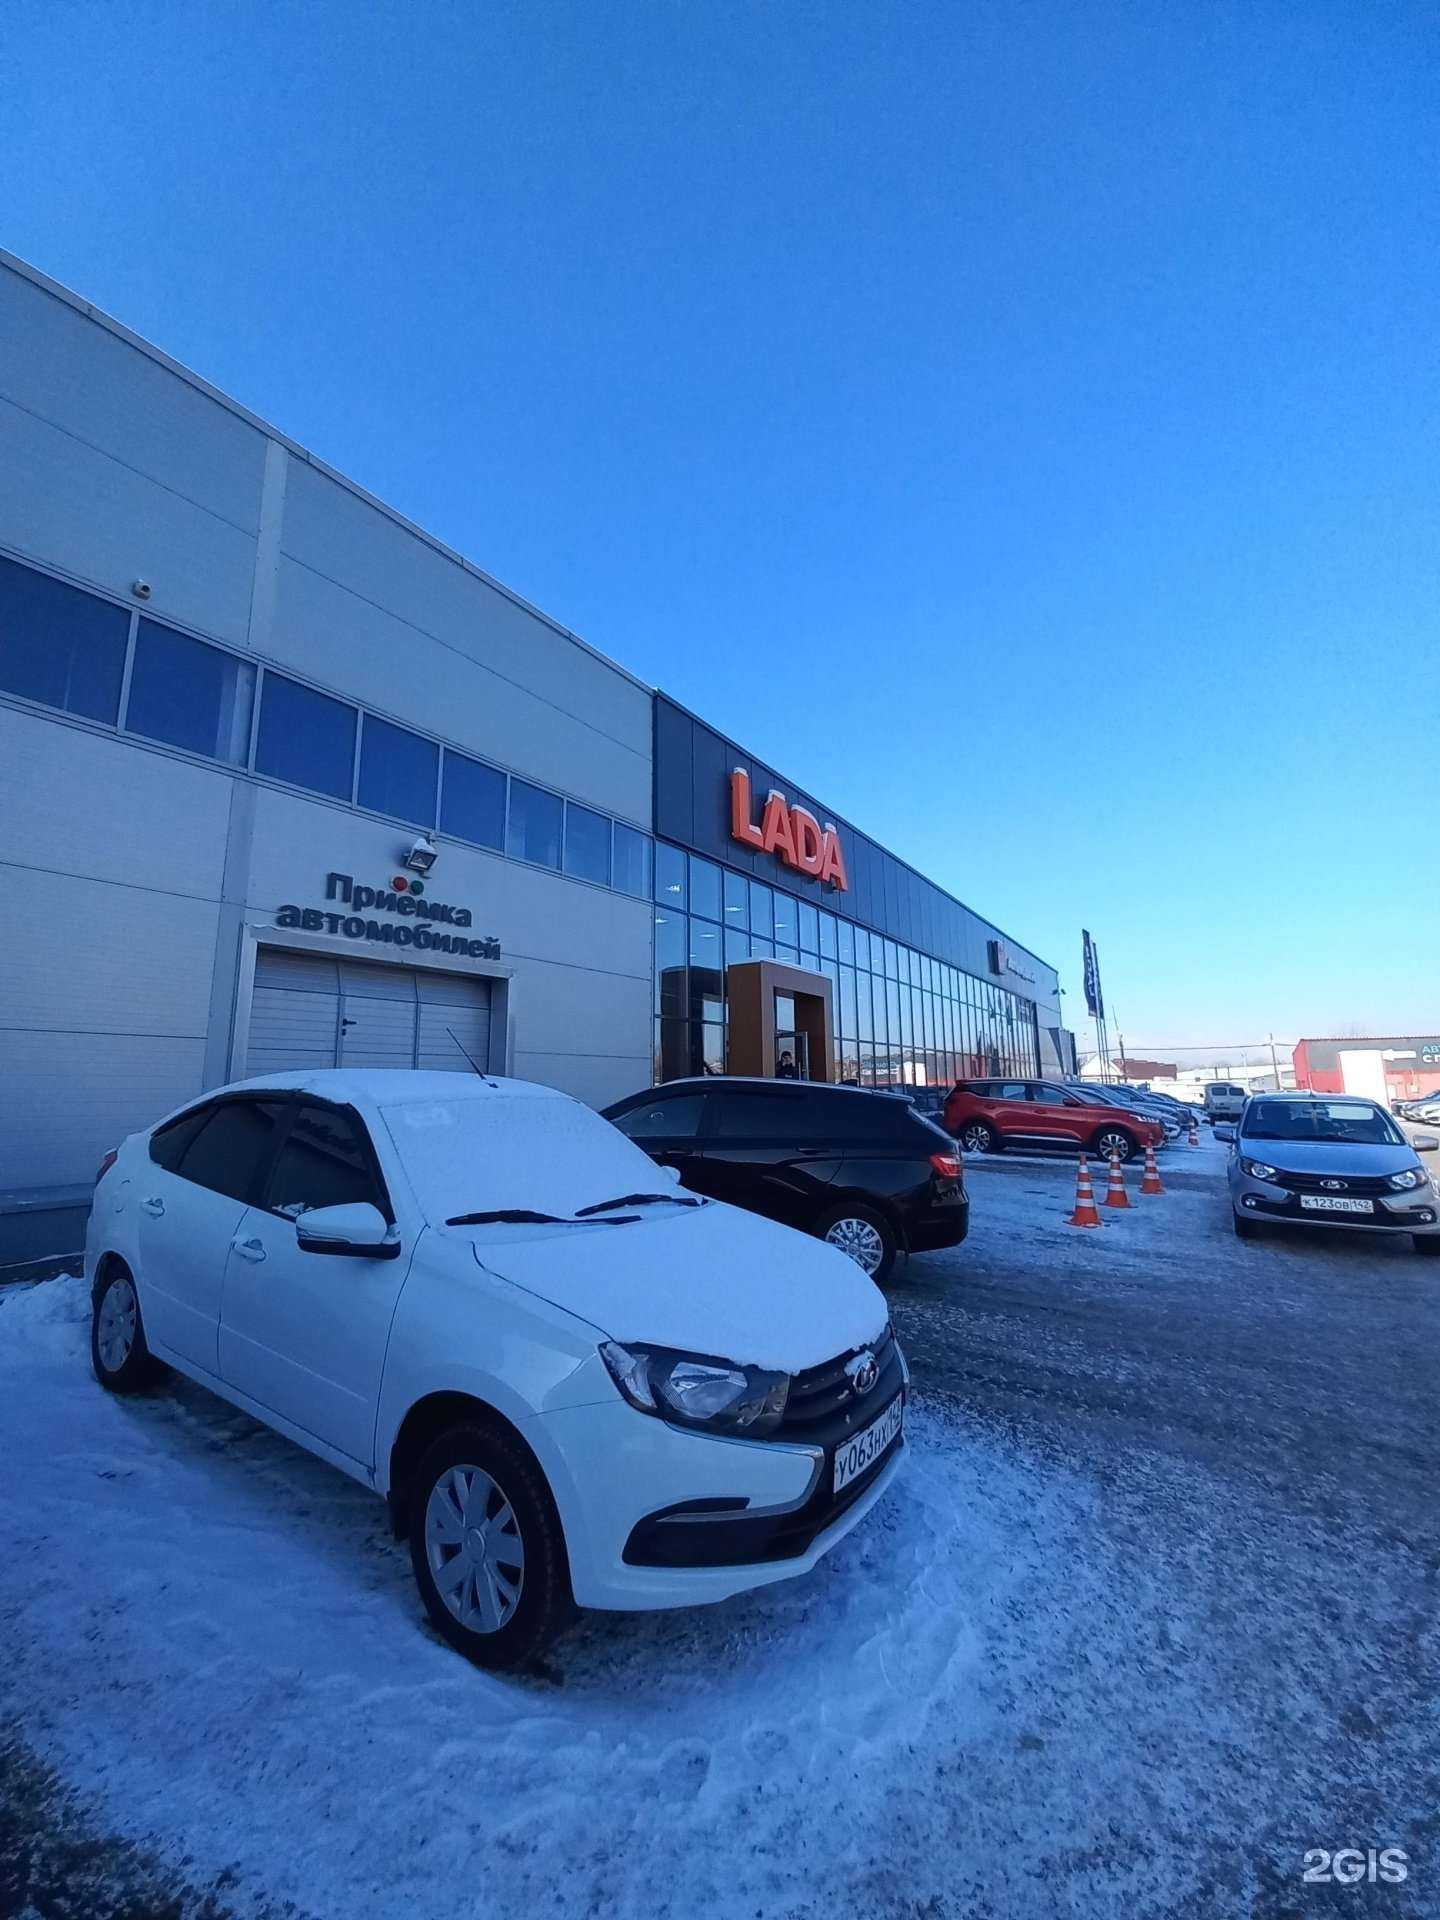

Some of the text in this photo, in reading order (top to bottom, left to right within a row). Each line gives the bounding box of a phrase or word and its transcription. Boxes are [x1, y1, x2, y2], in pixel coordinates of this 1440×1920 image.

[730, 769, 848, 891] LADA
[325, 872, 473, 928] Приёмка
[276, 904, 501, 961] автомобилей
